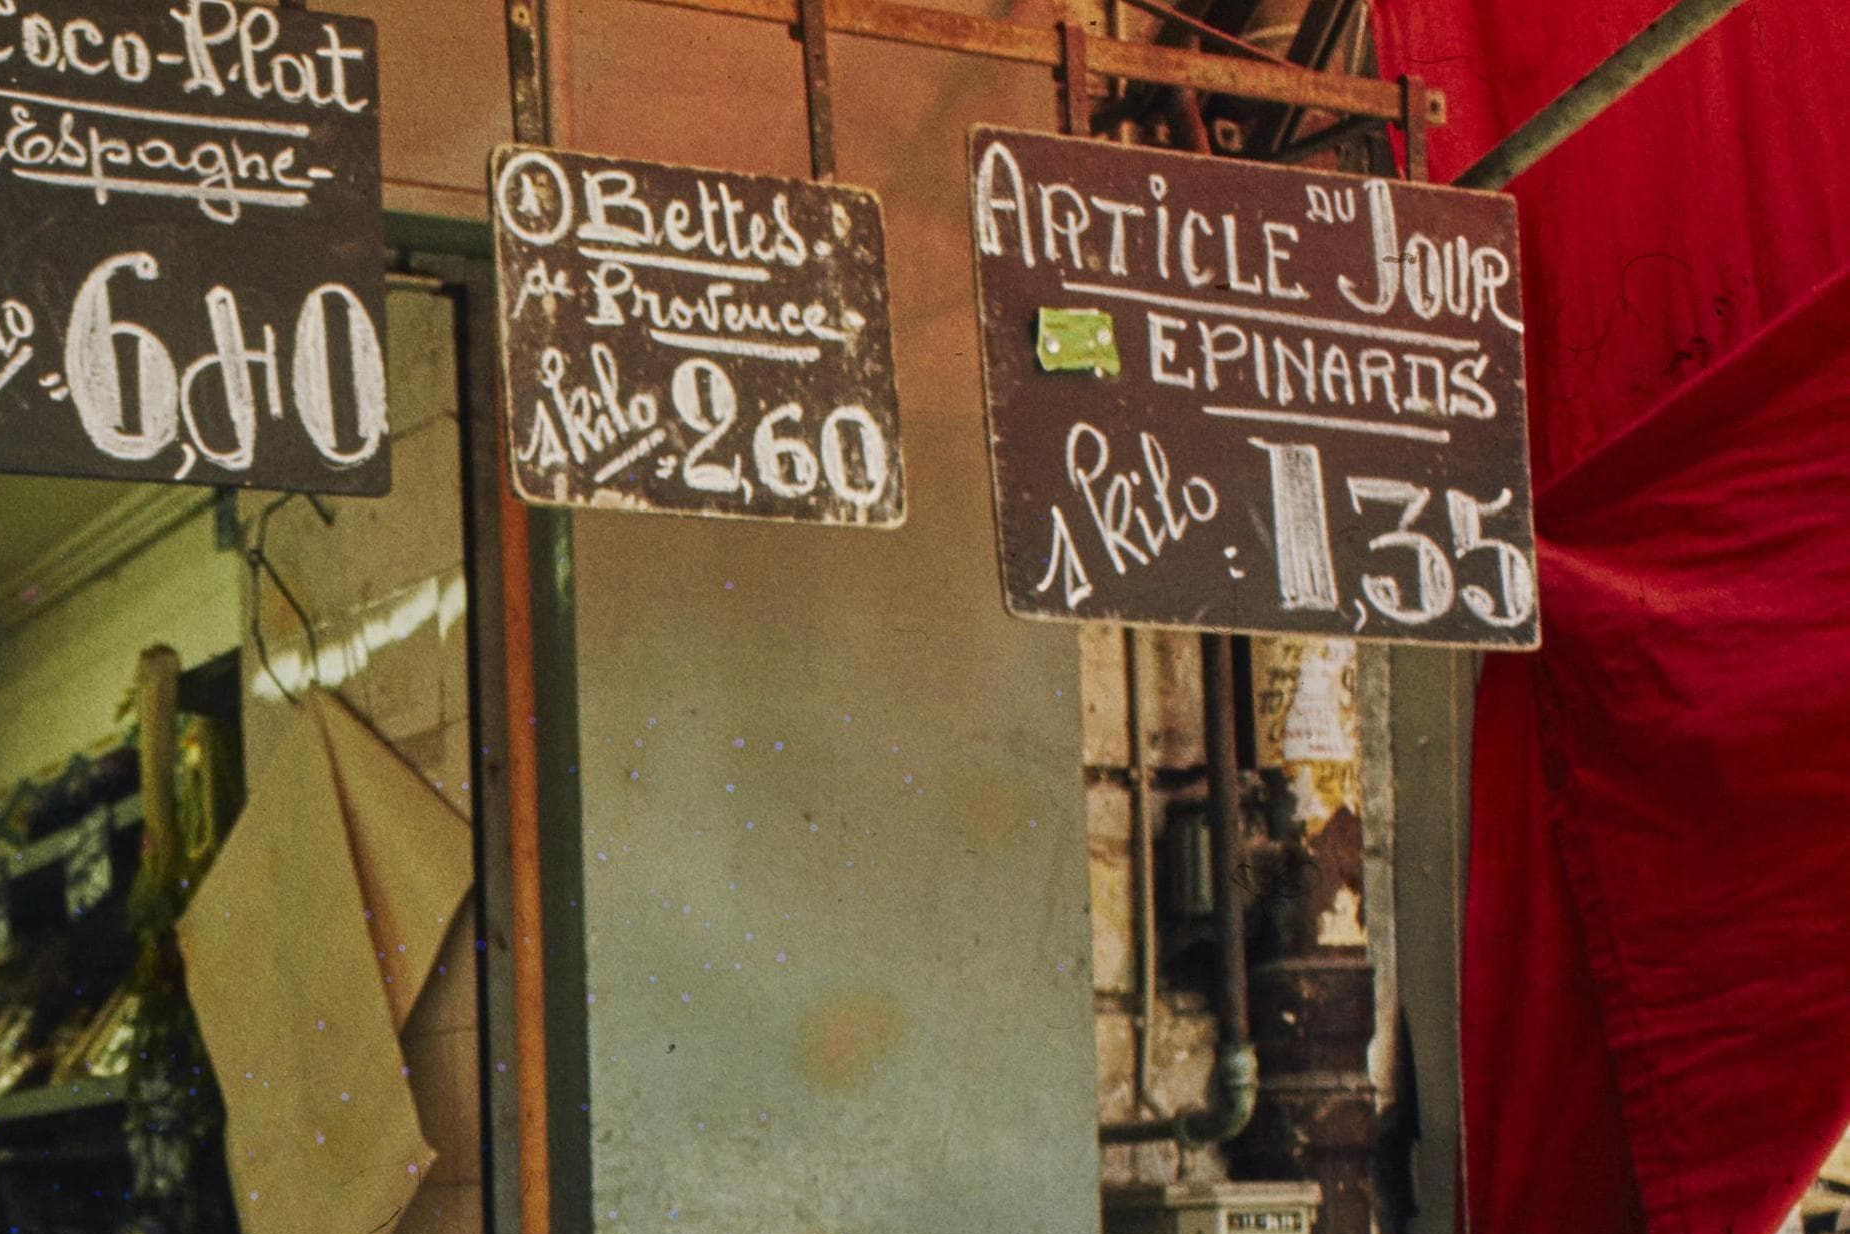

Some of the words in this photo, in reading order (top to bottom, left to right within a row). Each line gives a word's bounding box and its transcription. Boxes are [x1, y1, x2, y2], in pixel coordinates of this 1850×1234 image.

[1338, 177, 1524, 334] JOUR
[64, 251, 390, 480] 6,40
[671, 357, 888, 505] 2,60
[1148, 309, 1496, 419] EPINARDS
[1248, 436, 1538, 632] 1,35
